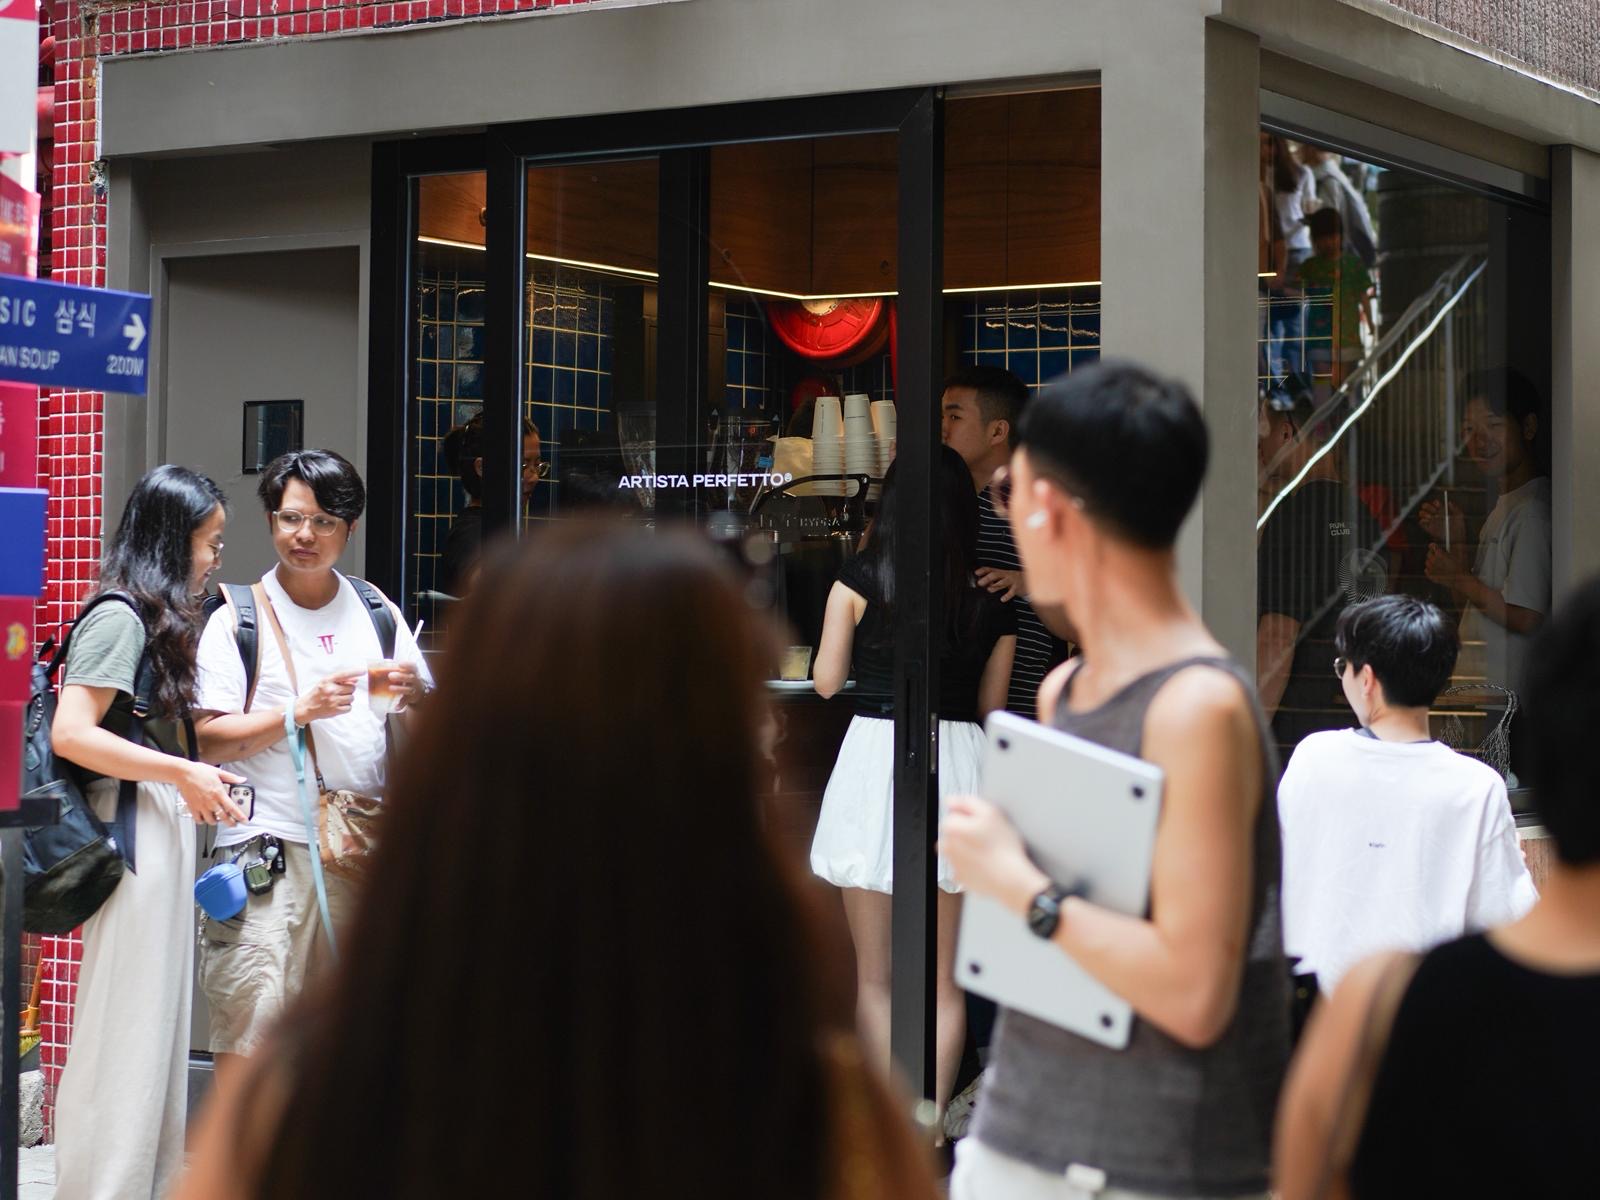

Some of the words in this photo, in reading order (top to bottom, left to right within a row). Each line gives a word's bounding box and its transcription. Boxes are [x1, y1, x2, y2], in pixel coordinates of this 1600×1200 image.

[54, 299, 97, 338] 삼식
[19, 346, 61, 371] SOUP
[106, 354, 145, 377] 200M
[618, 474, 690, 489] ARTISTA
[1329, 522, 1345, 530] RUN
[1331, 528, 1350, 536] CLUB
